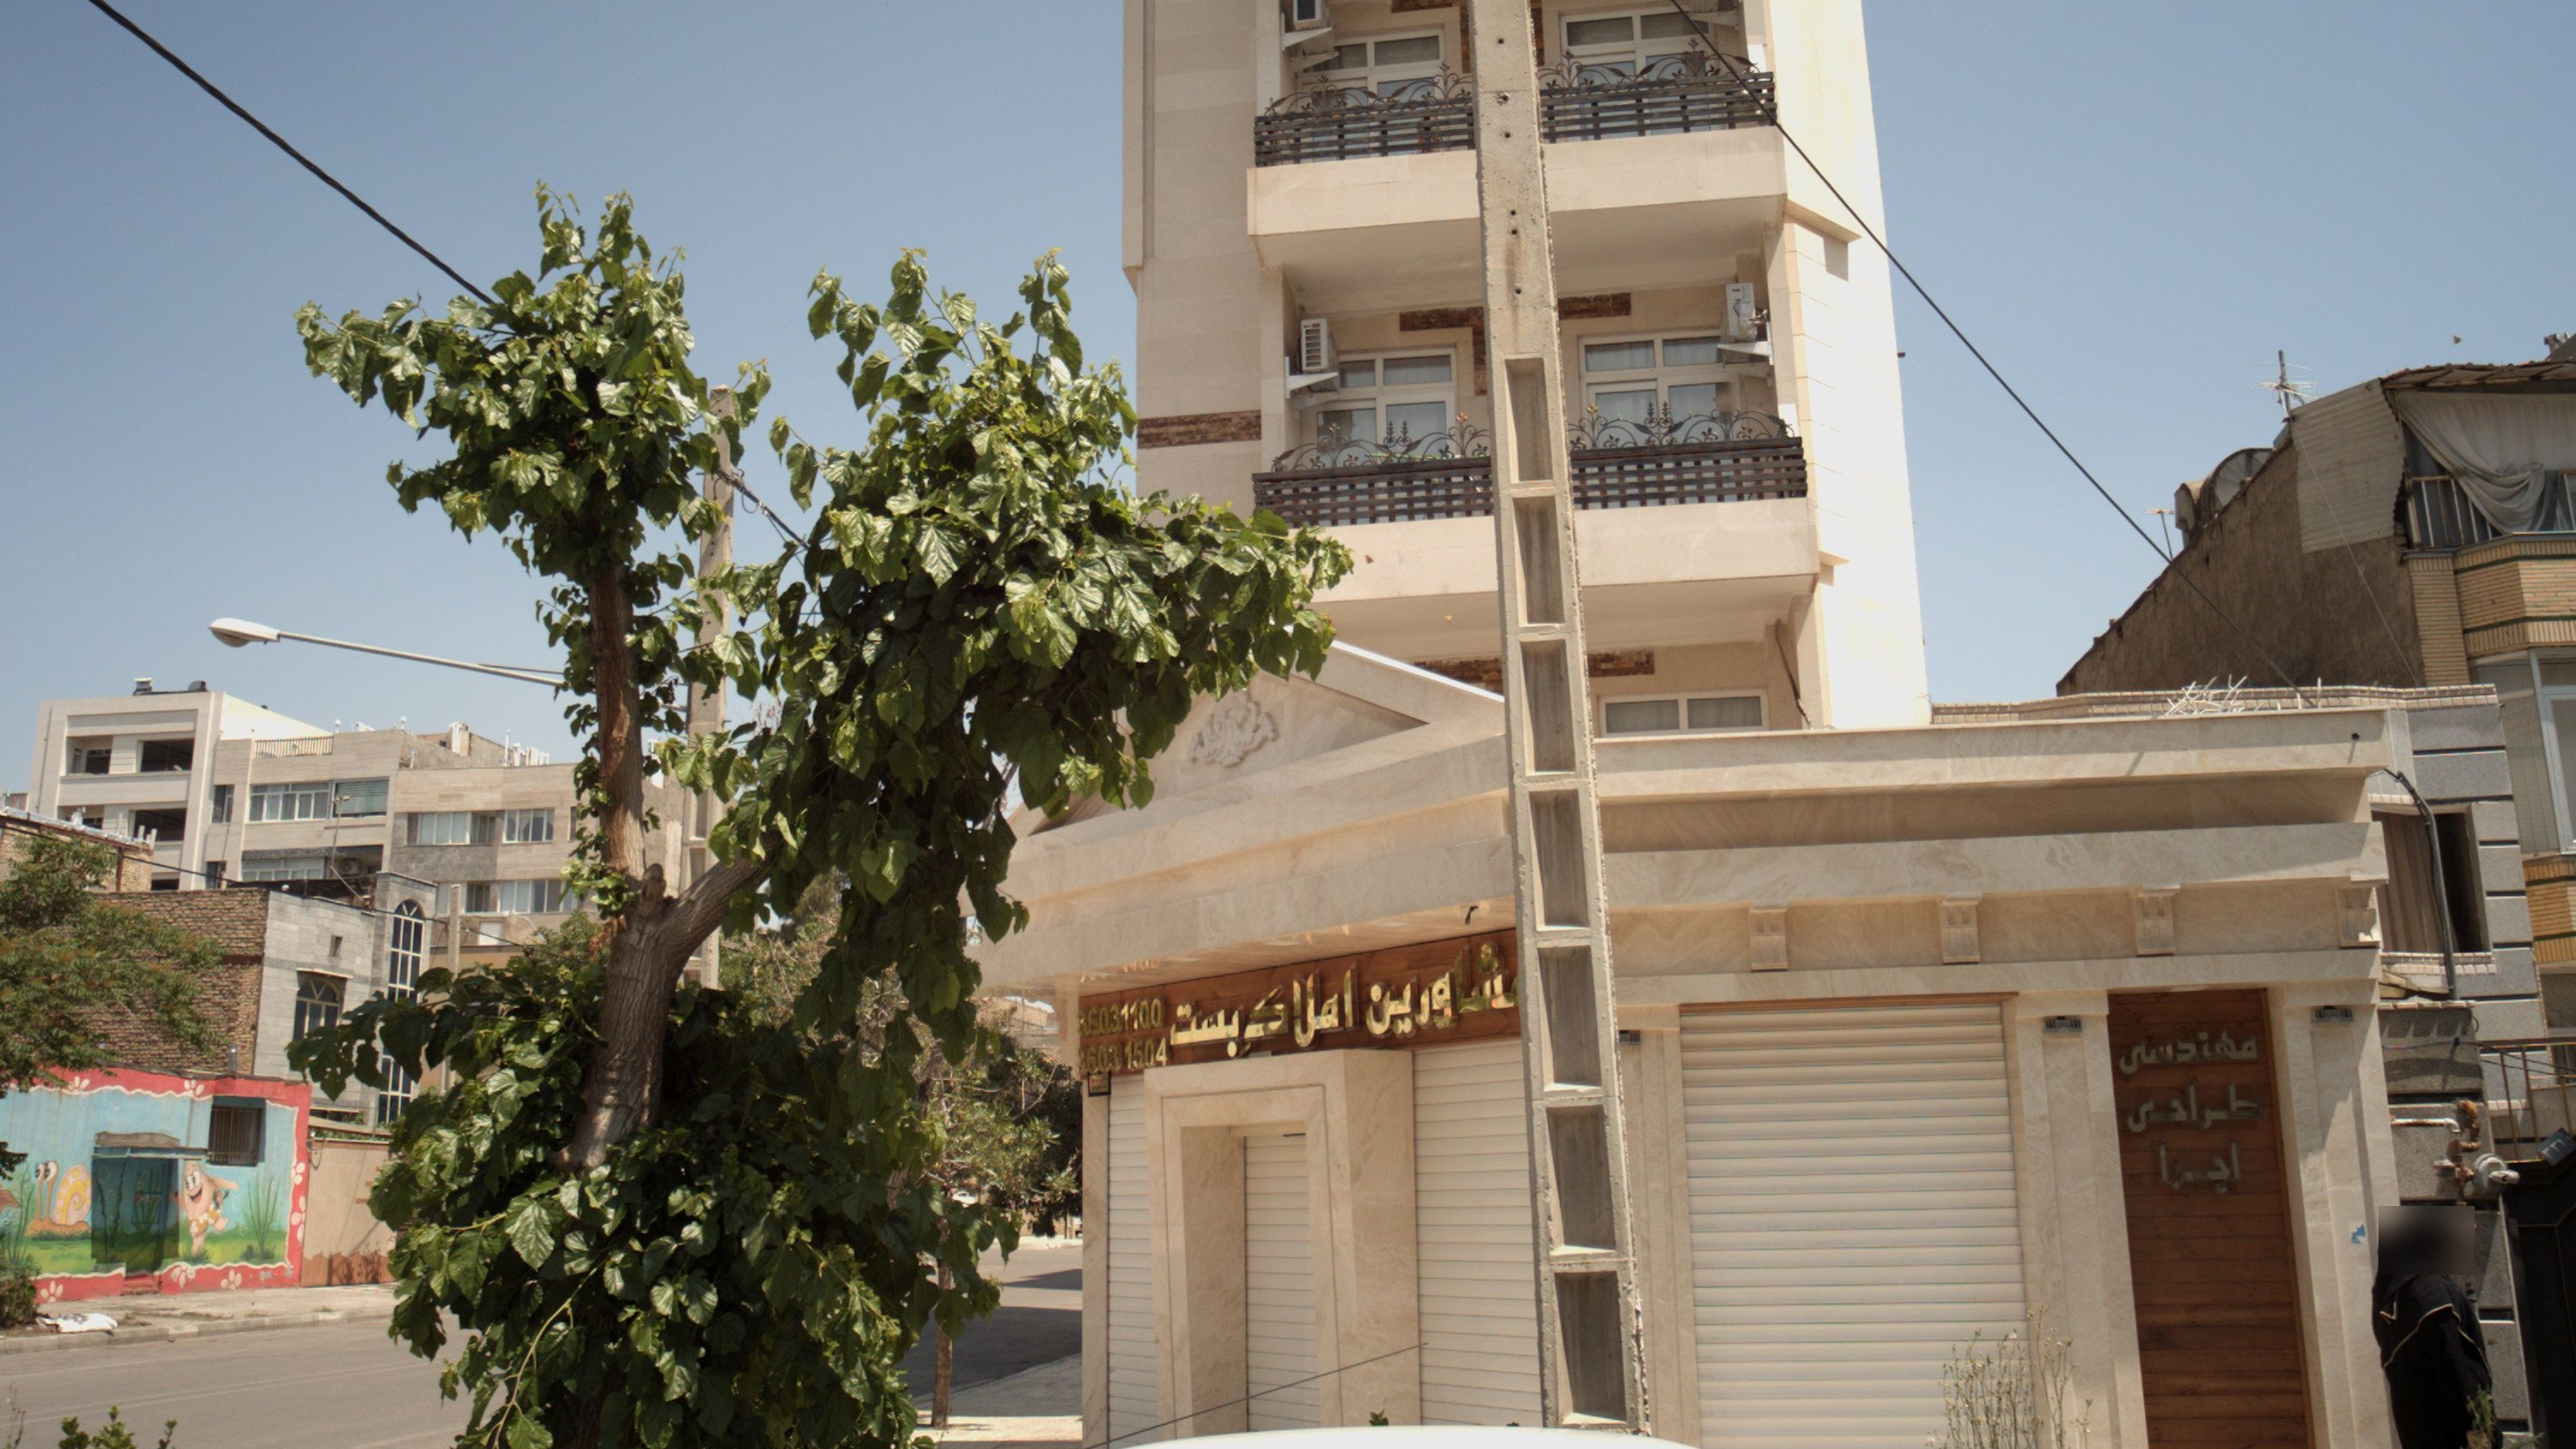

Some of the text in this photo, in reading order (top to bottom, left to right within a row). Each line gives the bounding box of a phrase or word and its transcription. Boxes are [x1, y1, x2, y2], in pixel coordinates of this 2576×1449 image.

[1243, 962, 1357, 1048] املاک
[2119, 1029, 2258, 1075] مهندسی
[2127, 1080, 2263, 1132] طراحی
[2158, 1141, 2241, 1194] اجرا
